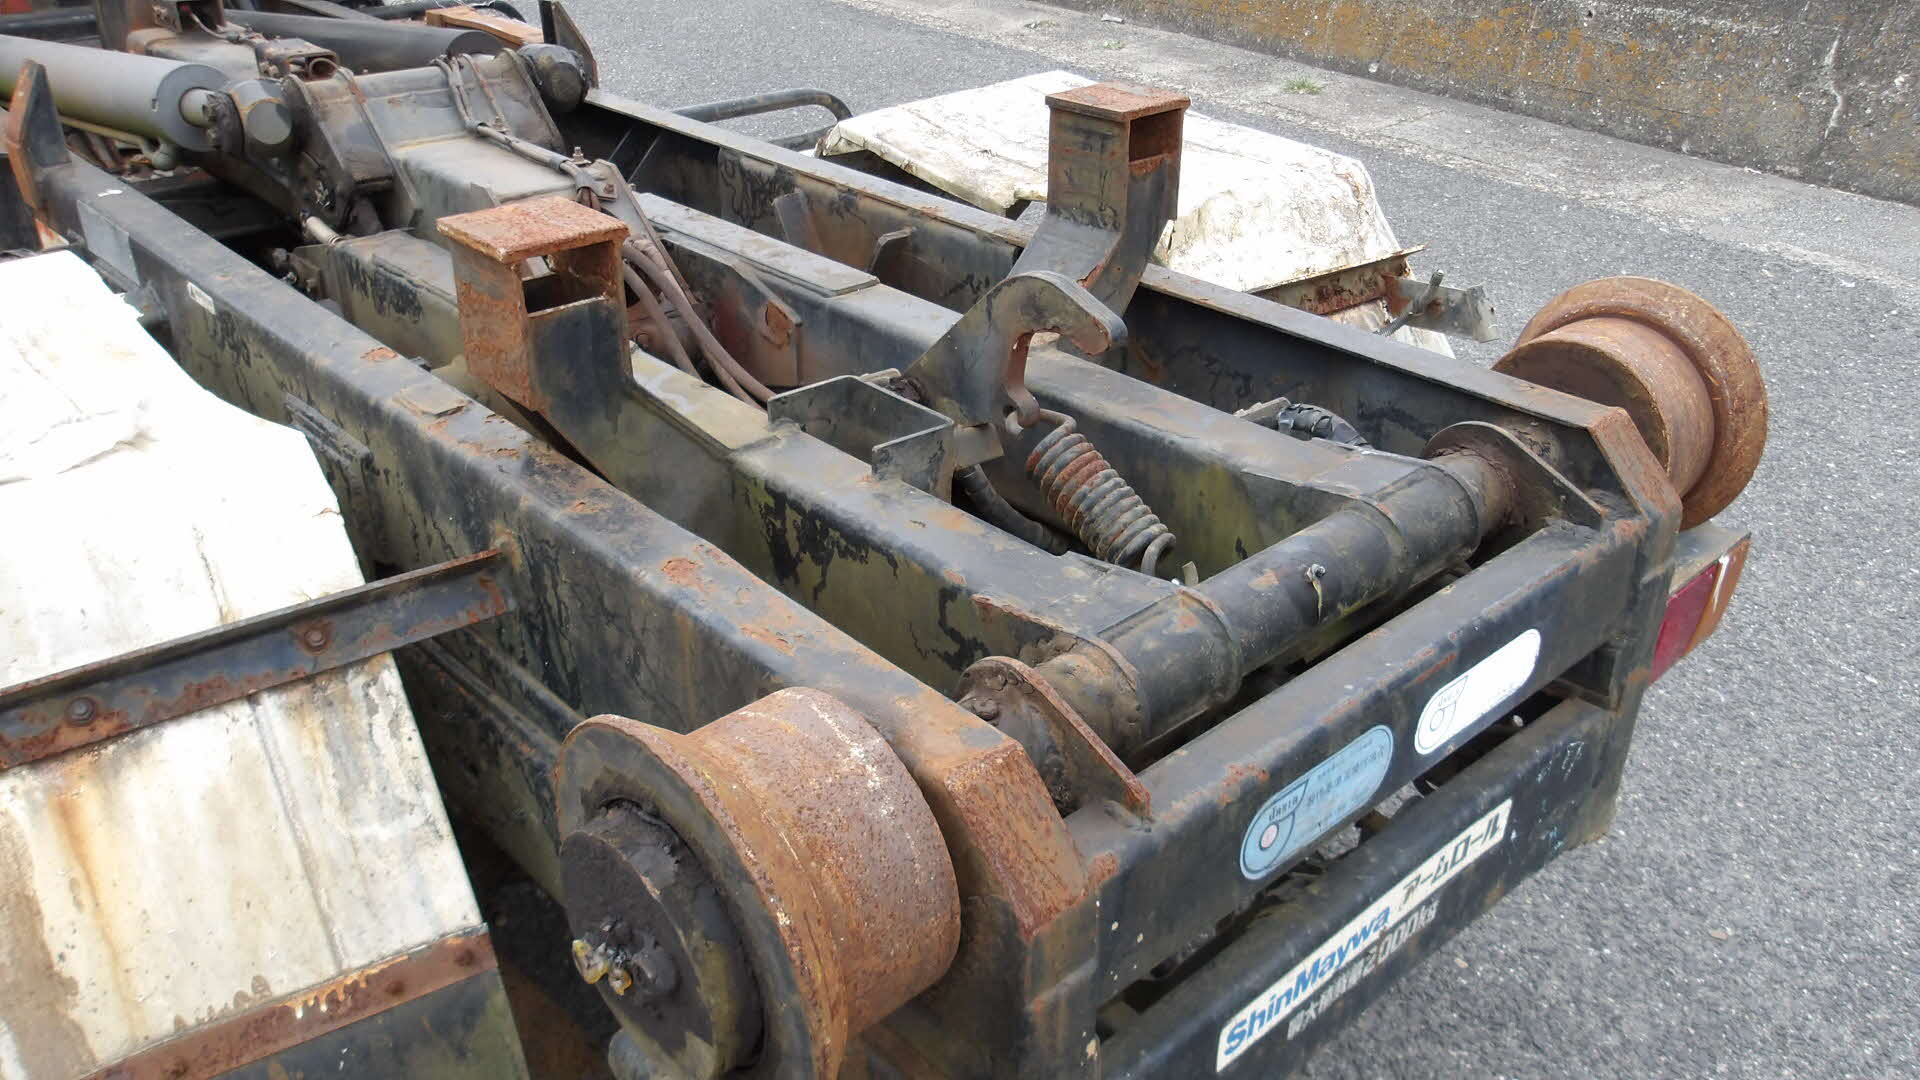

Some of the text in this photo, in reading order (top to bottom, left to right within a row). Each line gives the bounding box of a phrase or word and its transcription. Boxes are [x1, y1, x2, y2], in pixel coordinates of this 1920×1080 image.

[1224, 812, 1502, 1056] ShinMaywa アームロール
